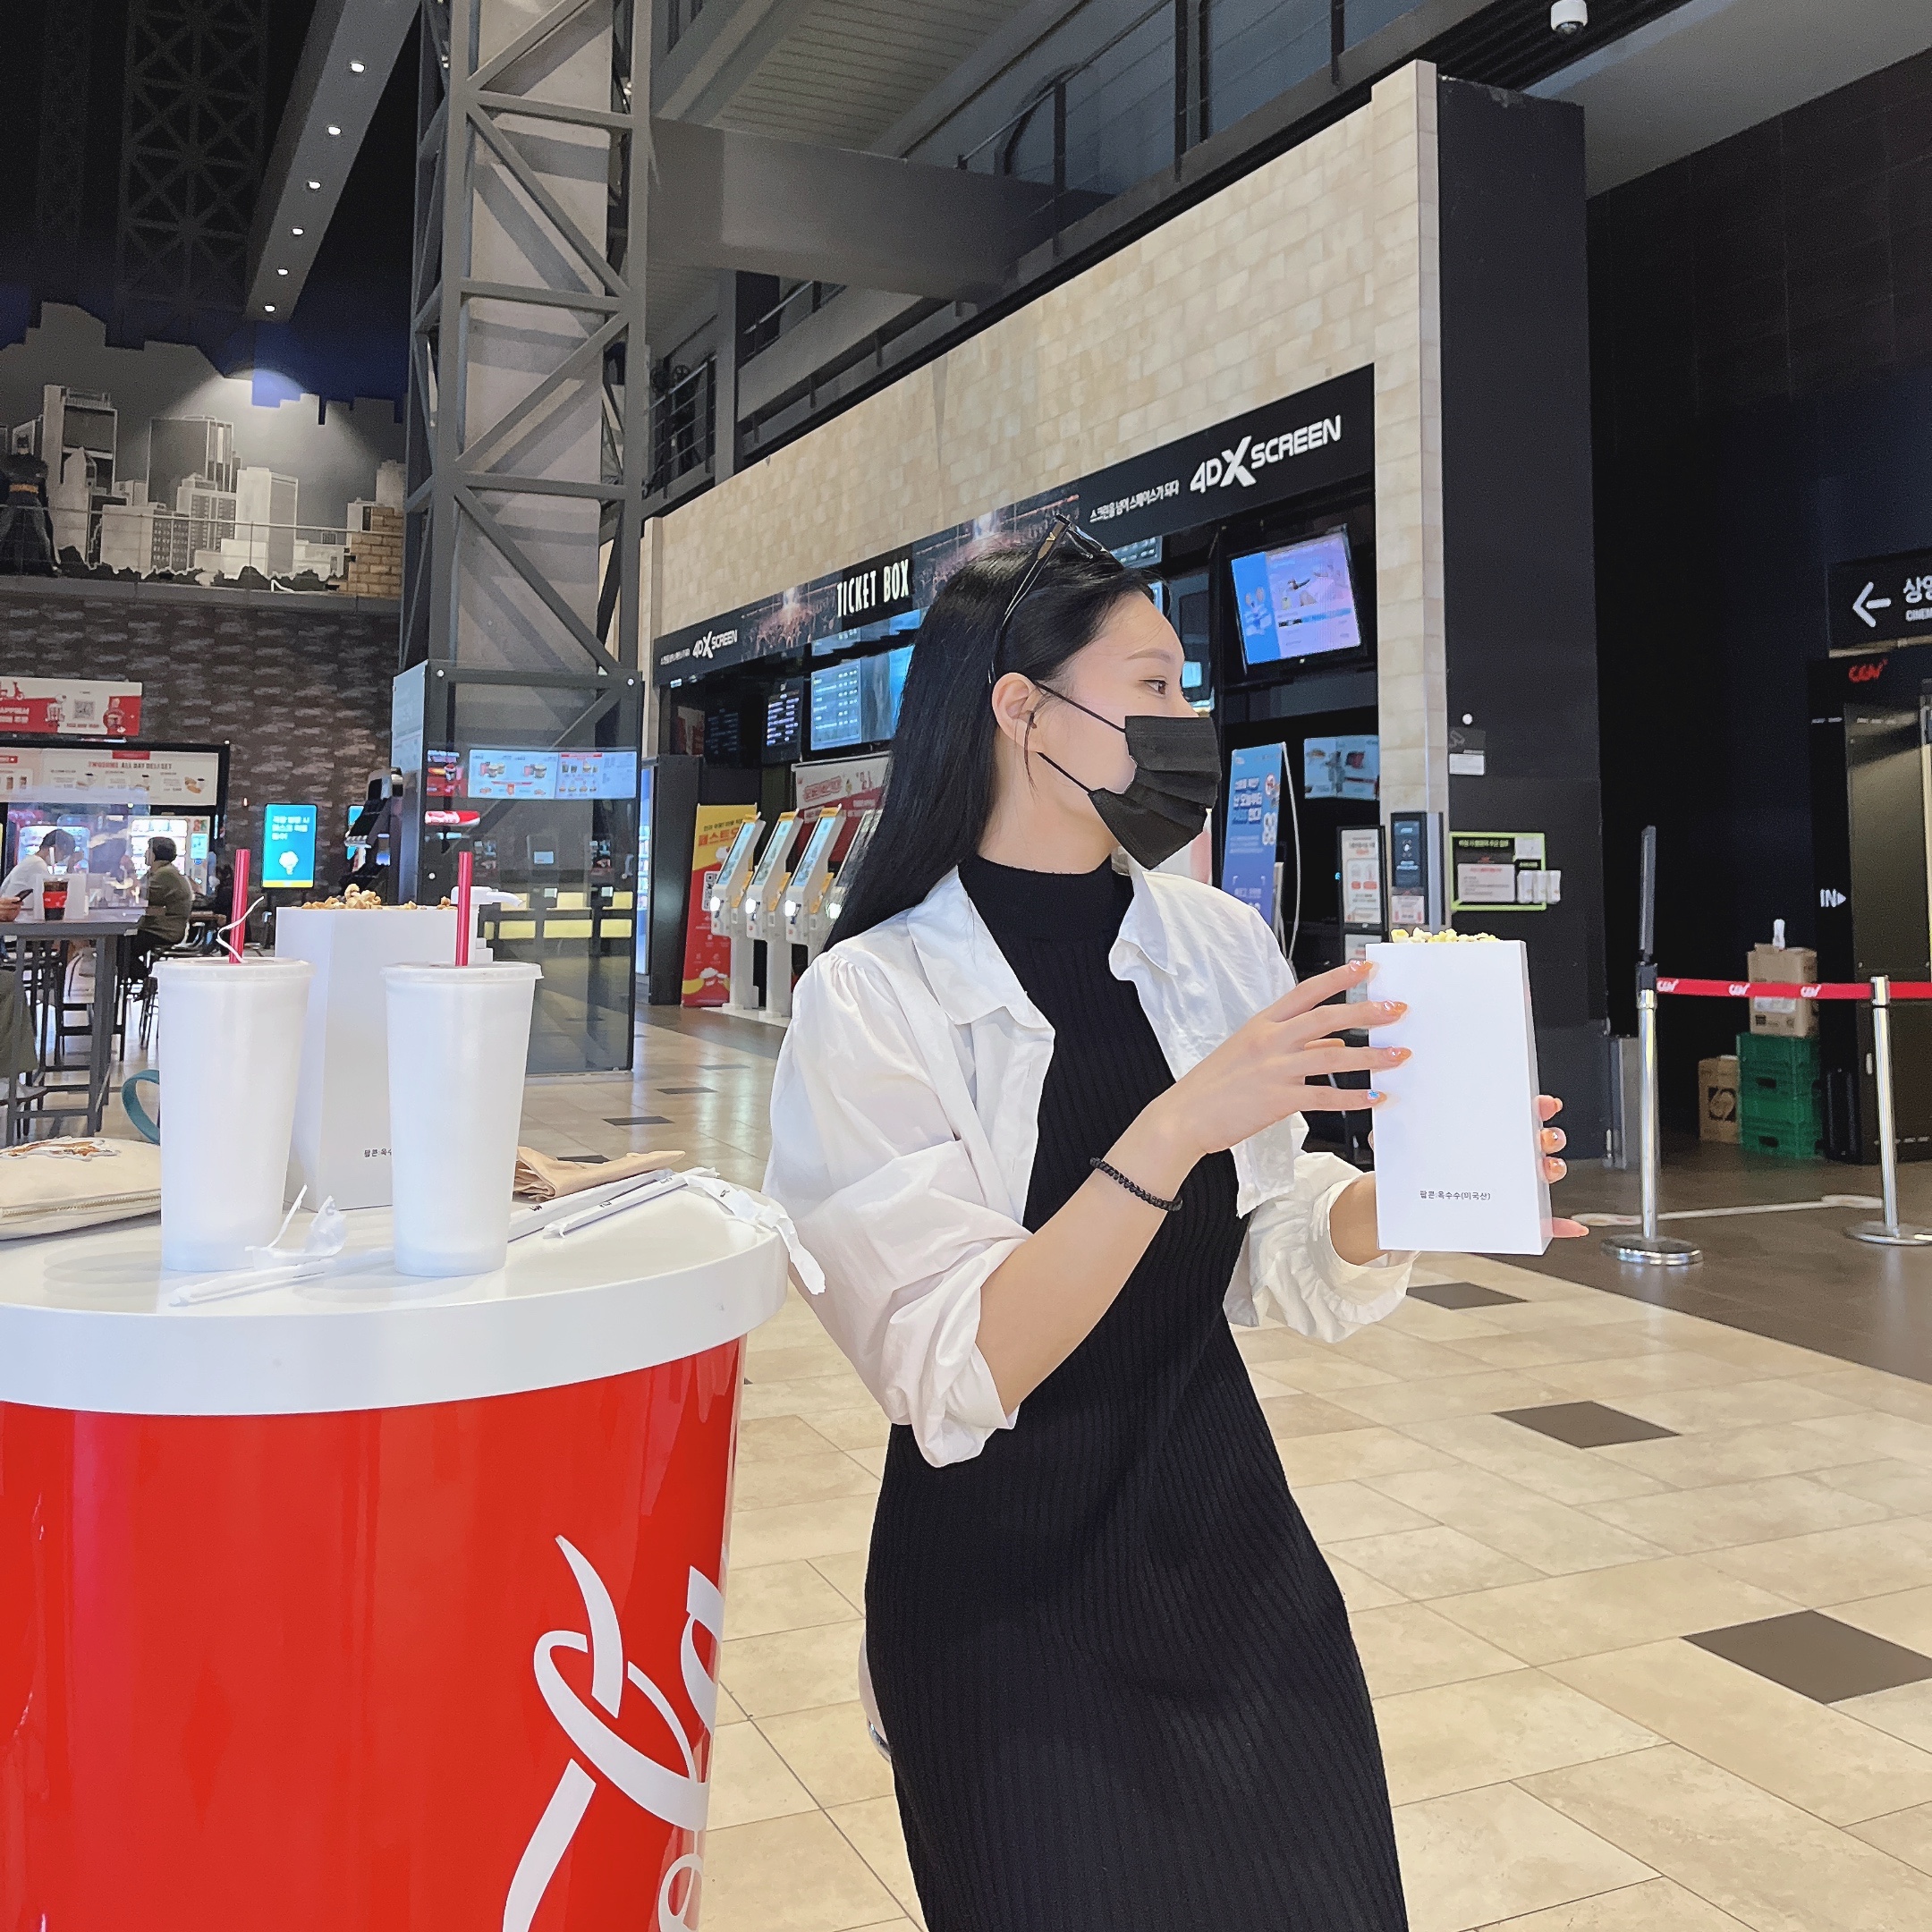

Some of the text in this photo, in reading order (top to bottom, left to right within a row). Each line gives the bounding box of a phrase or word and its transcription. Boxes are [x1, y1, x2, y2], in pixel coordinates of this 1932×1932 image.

[1190, 414, 1342, 493] 4DX SCREEN
[836, 559, 910, 617] TICKET BOX
[692, 631, 714, 658] 4DX
[711, 629, 738, 650] SCREEN
[1819, 888, 1837, 908] IN
